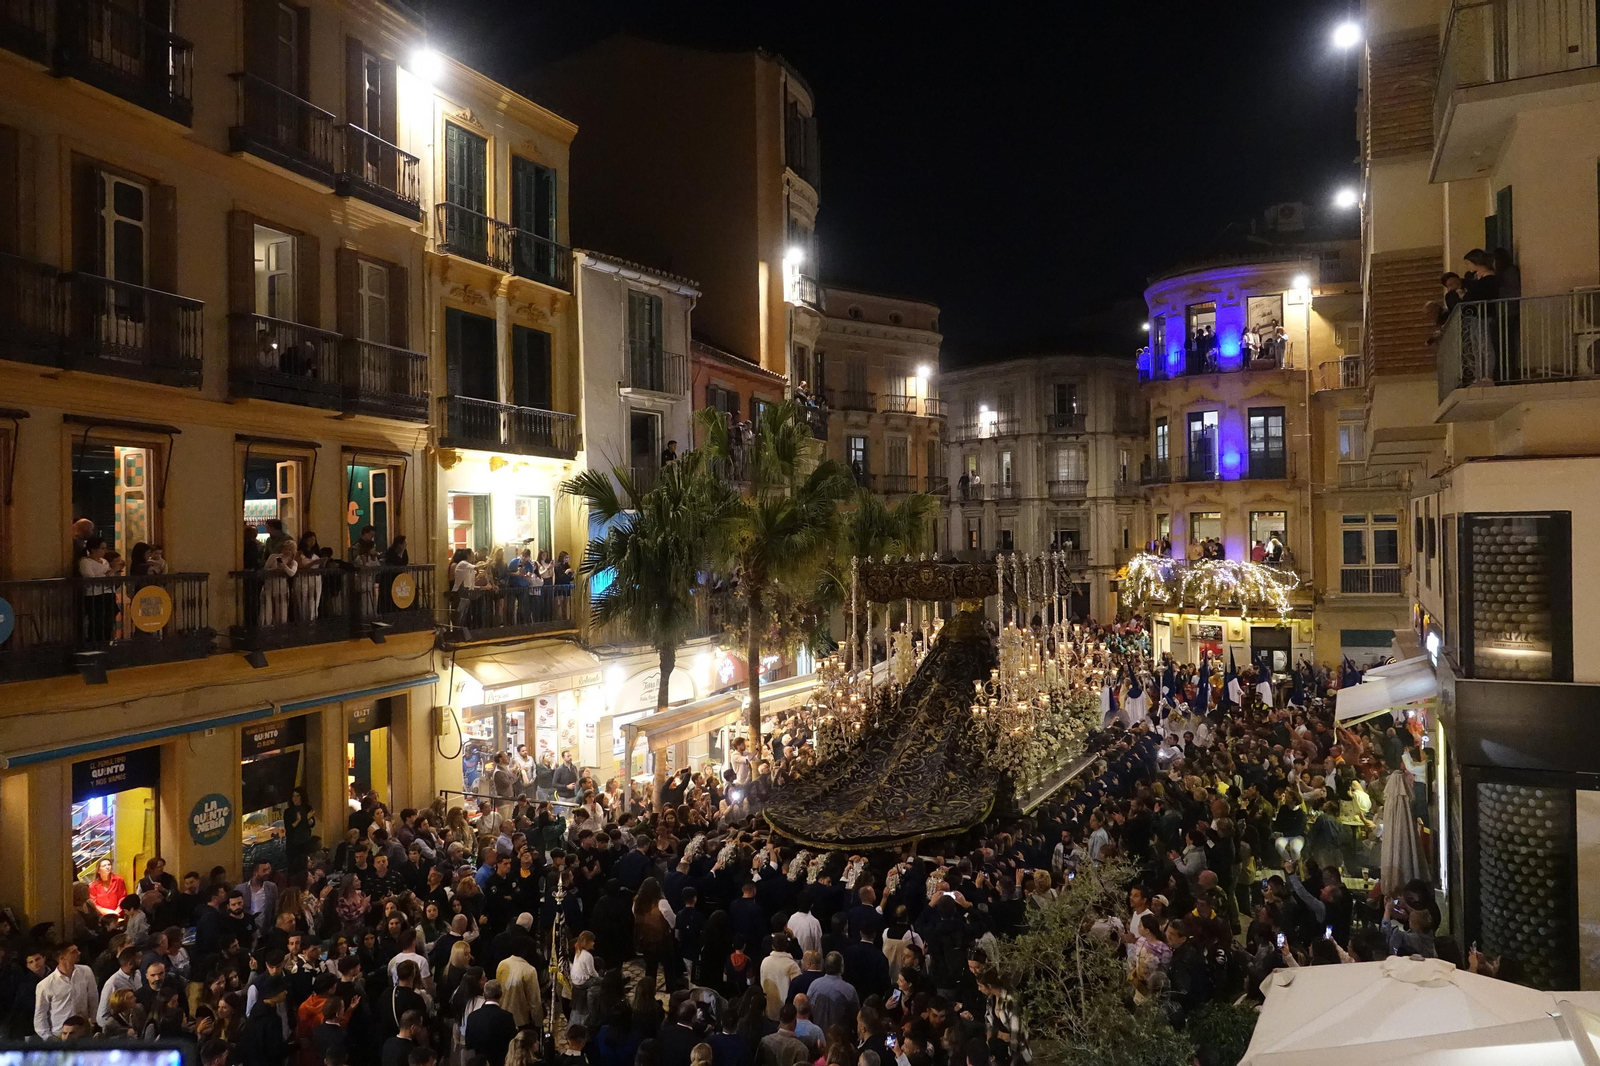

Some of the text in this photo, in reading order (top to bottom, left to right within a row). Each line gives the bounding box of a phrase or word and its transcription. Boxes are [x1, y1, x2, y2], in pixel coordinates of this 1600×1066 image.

[253, 729, 279, 742] QUINTO
[91, 763, 125, 778] QUINTO
[204, 800, 218, 812] LA
[193, 806, 230, 825] QUINTO
